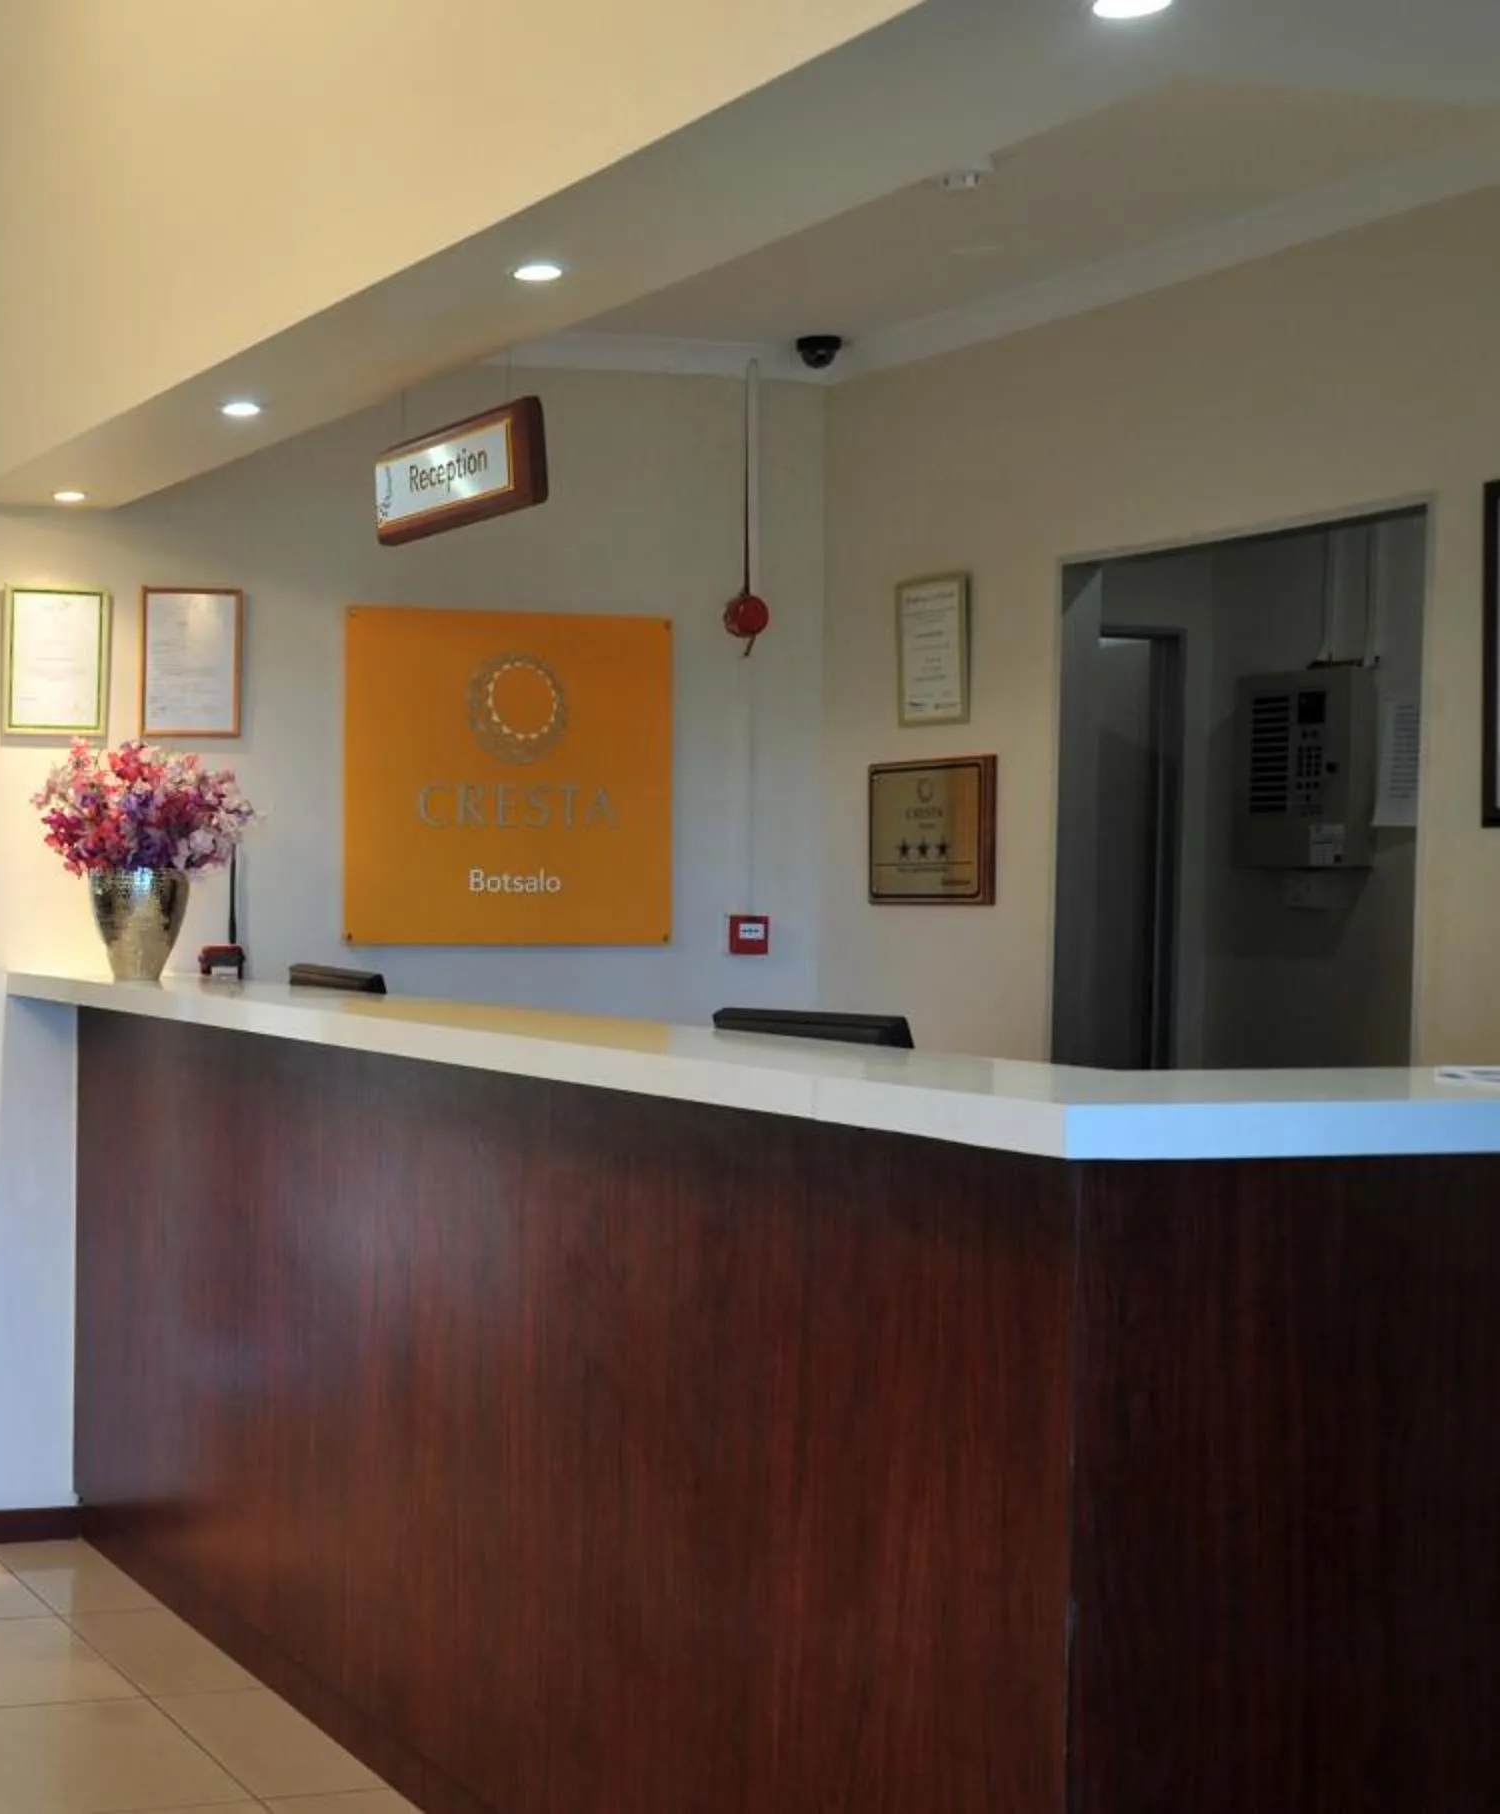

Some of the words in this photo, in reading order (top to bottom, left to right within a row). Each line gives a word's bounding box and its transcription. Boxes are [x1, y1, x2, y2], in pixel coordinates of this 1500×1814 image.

[408, 448, 488, 494] Reception
[418, 781, 618, 831] CRESTA
[468, 867, 561, 893] Botsalo
